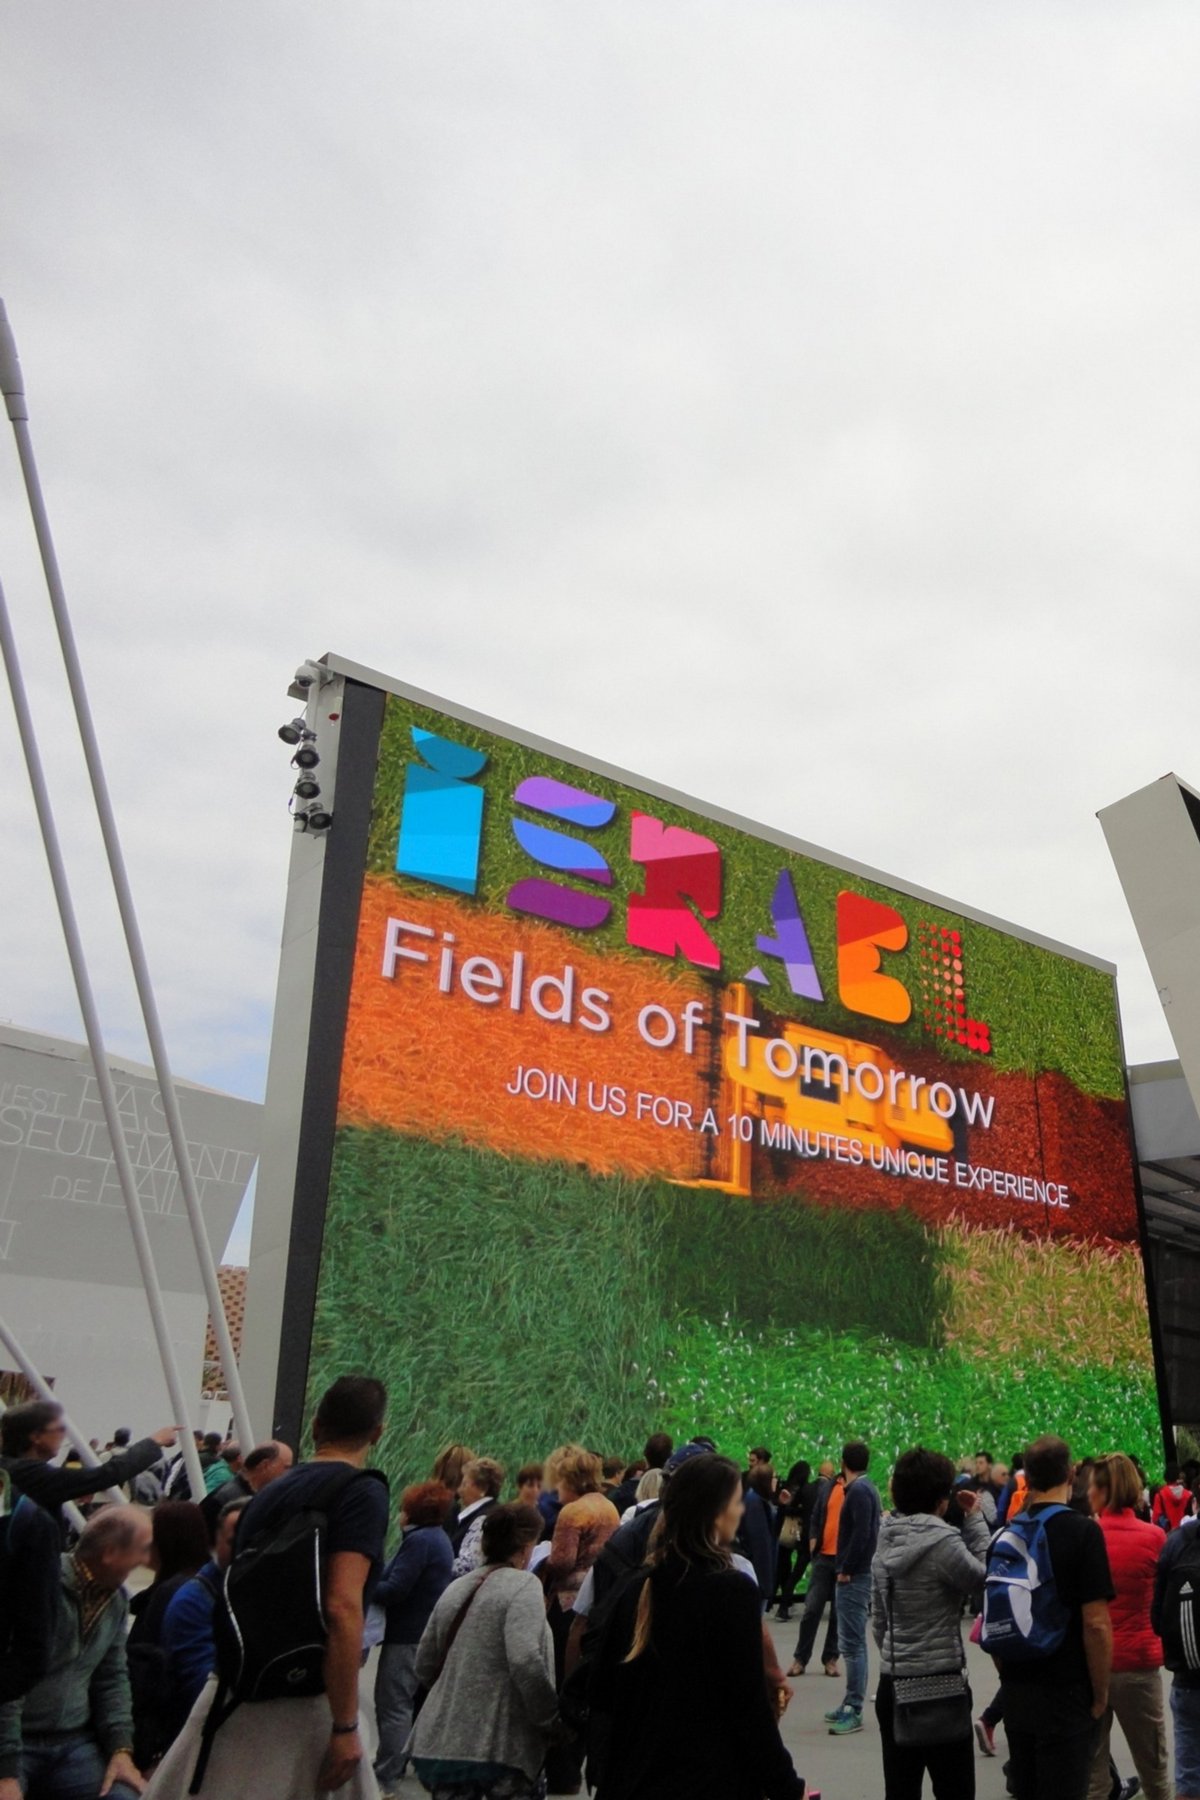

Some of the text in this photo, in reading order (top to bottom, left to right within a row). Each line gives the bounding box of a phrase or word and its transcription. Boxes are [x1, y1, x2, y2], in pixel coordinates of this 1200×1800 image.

[381, 917, 996, 1130] Fields of Tomorrow
[49, 1175, 92, 1202] DE
[506, 1065, 1071, 1208] JOIN US FOR A 10 MINUTES UNIQUE EXPERIENCE
